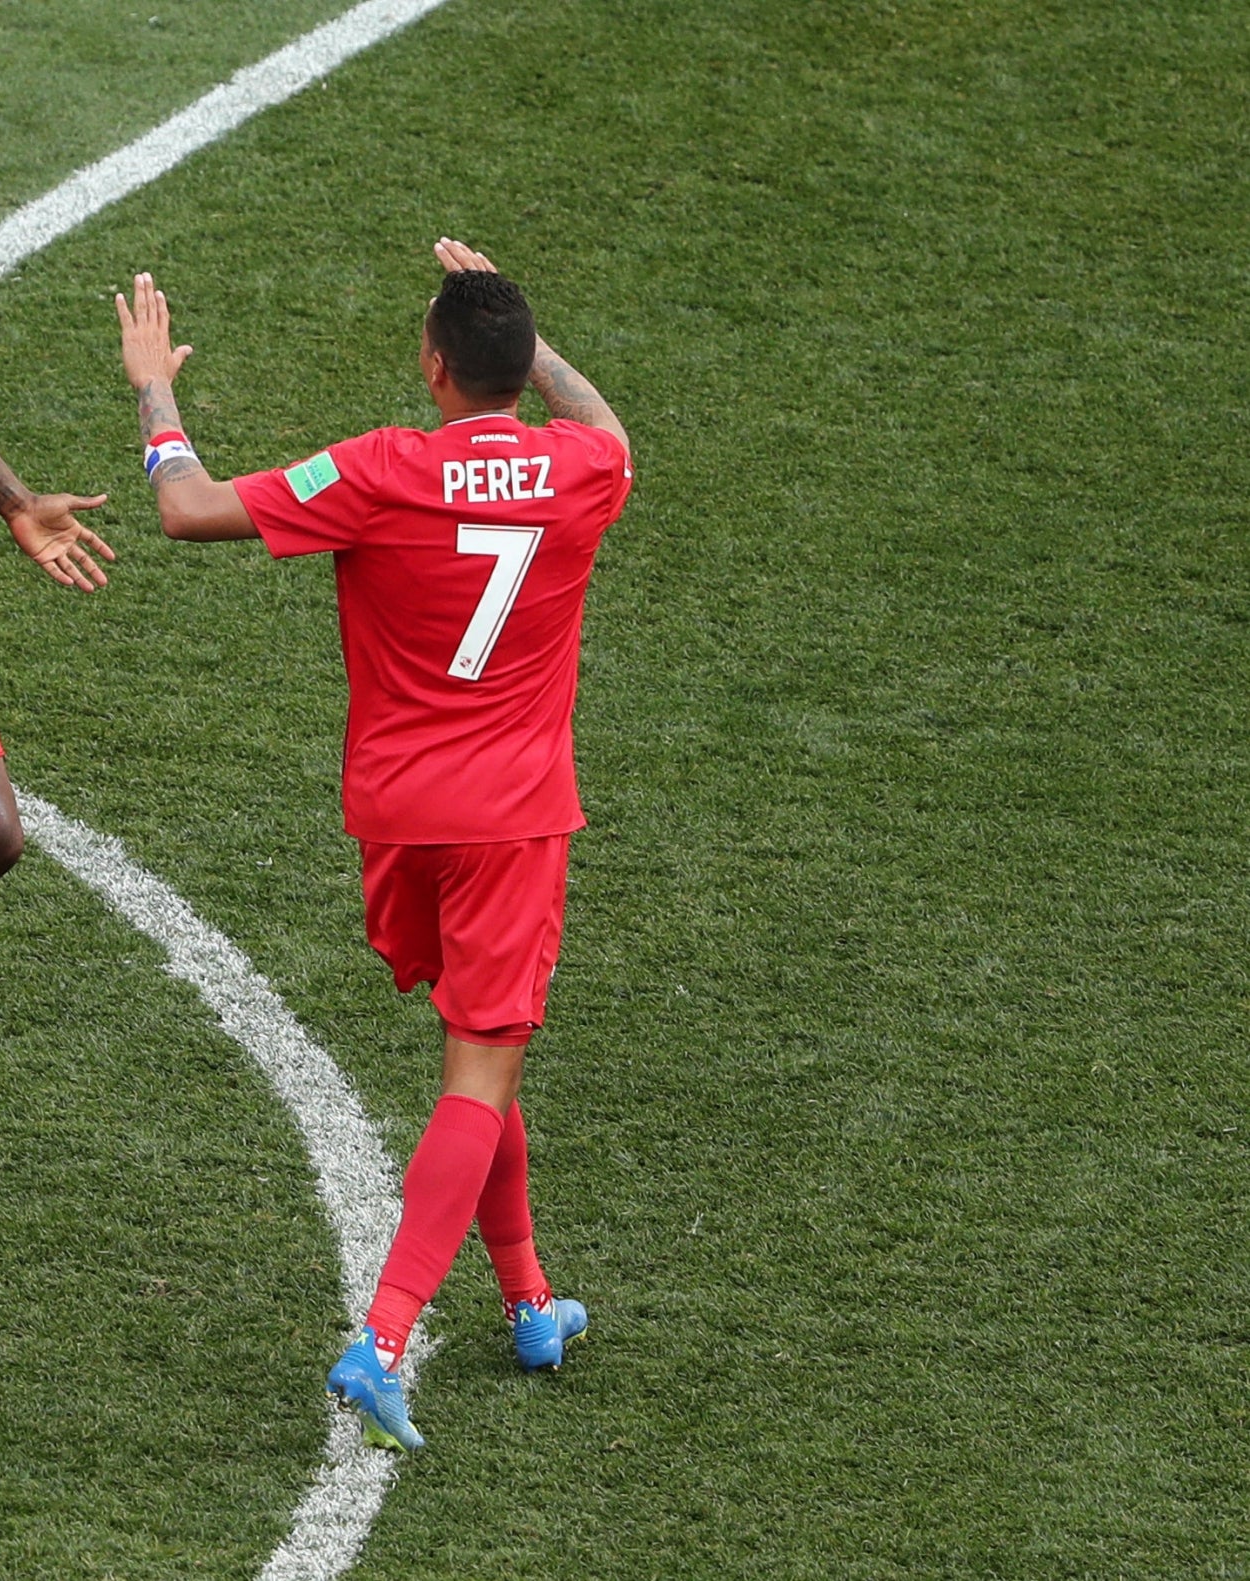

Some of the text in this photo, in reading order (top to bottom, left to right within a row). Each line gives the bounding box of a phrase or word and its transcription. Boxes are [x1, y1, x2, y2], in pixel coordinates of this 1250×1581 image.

[470, 433, 520, 445] PANAMA
[441, 455, 556, 504] PEREZ
[446, 523, 546, 682] 7
